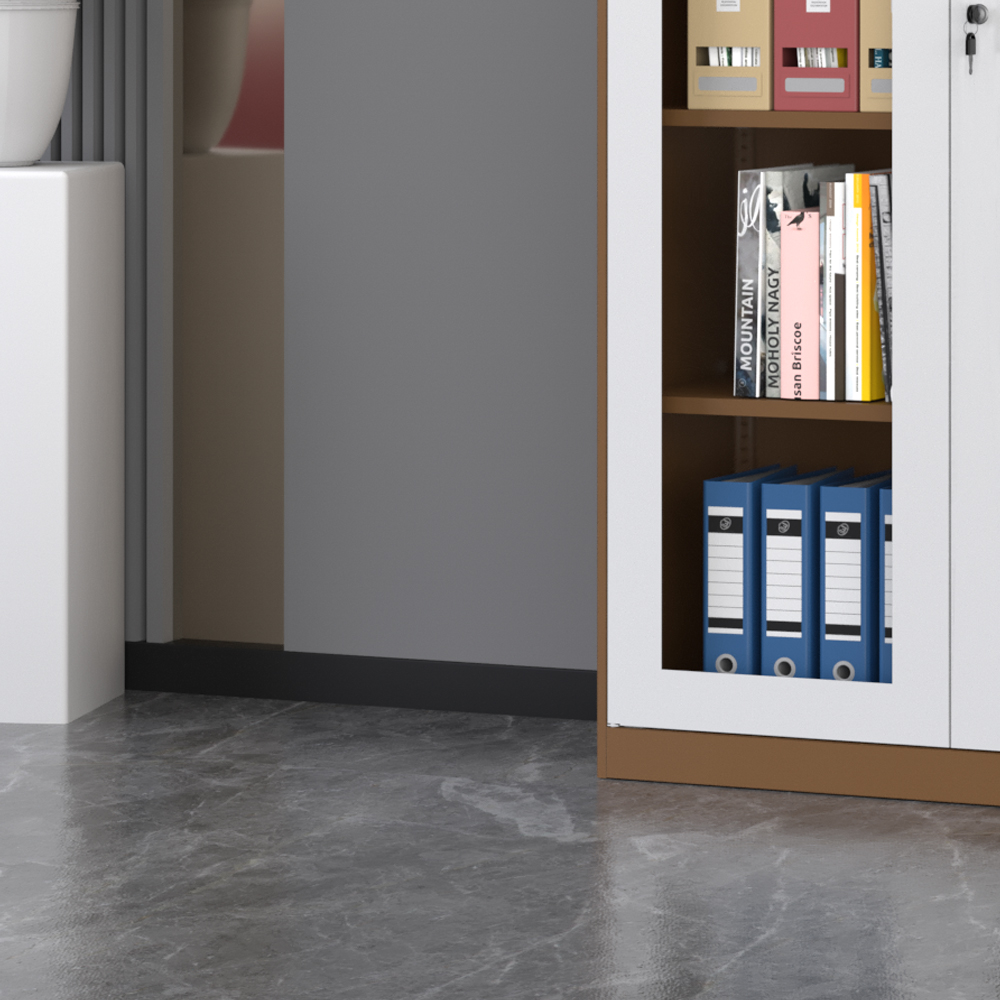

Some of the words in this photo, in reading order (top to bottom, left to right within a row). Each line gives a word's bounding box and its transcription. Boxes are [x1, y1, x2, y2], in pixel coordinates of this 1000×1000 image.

[767, 267, 780, 312] NAGY
[740, 279, 754, 371] MOUNTAIN
[767, 318, 780, 389] MOHOLY
[791, 322, 802, 370] Briscoe
